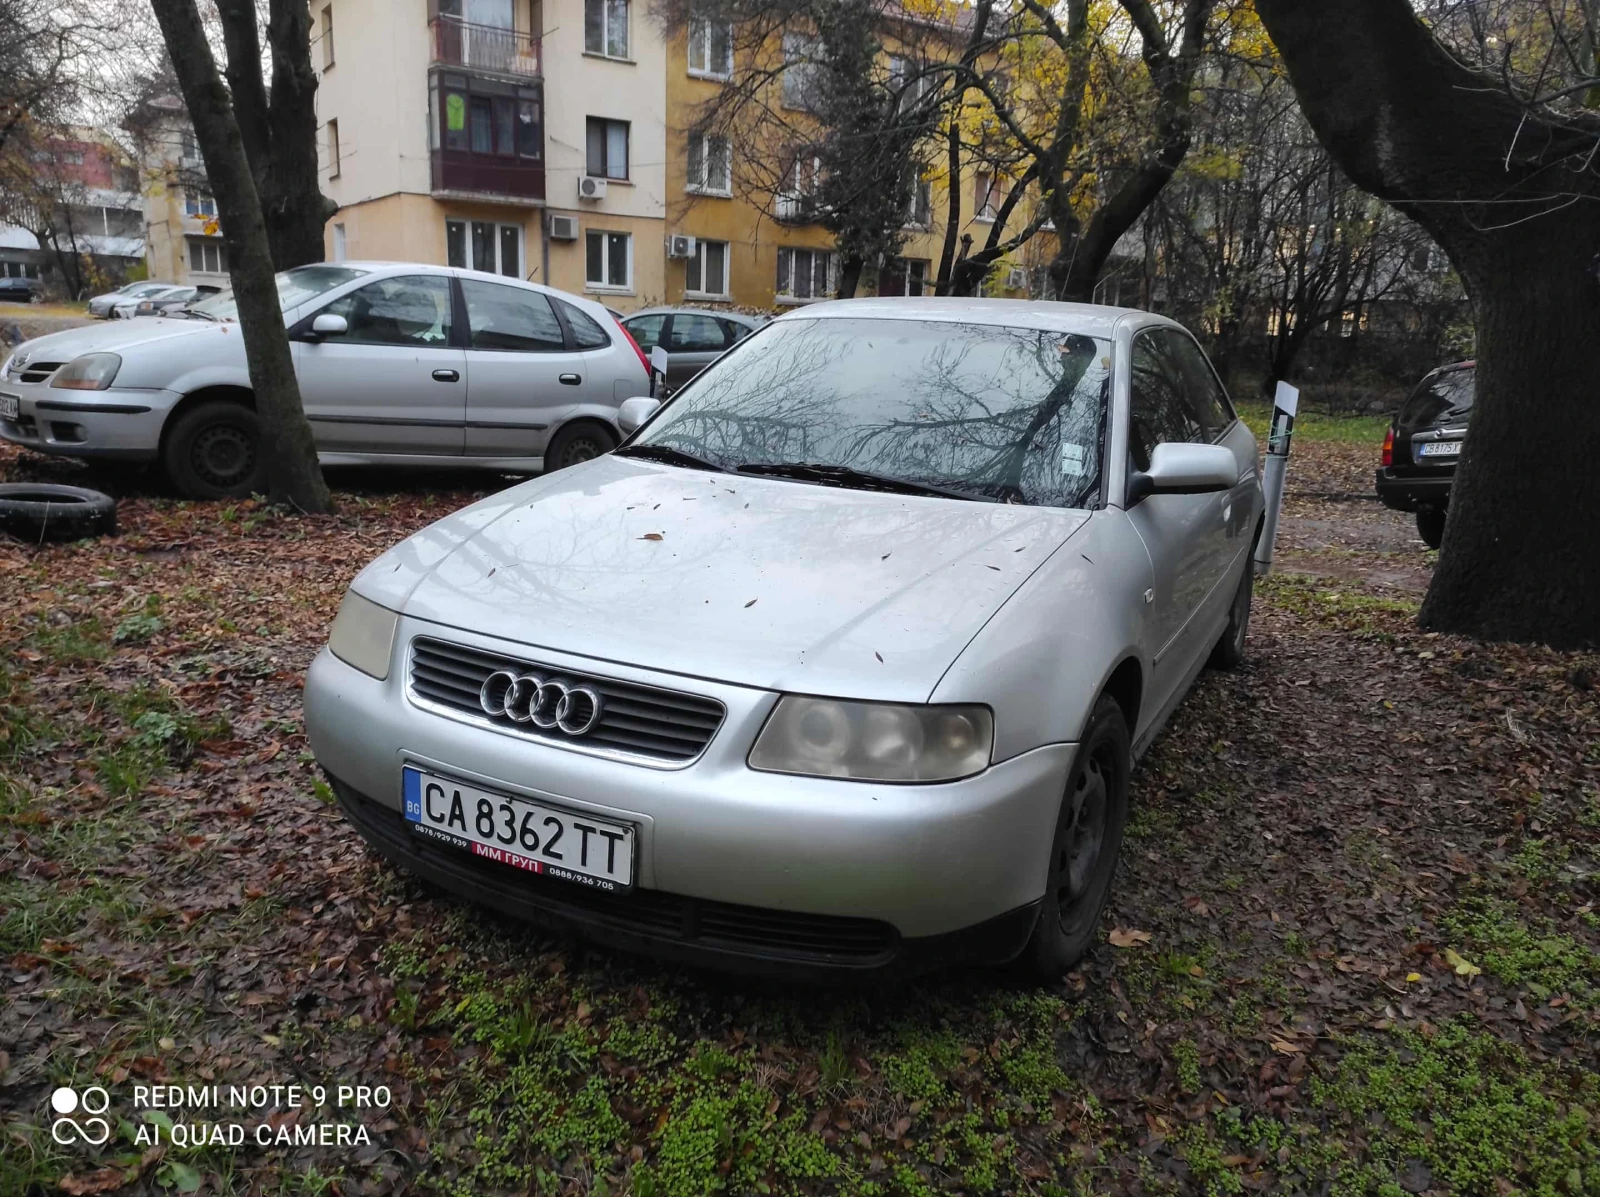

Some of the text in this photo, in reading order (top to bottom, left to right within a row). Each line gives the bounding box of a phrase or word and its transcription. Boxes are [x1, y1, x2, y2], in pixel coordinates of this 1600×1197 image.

[407, 800, 420, 815] BG
[425, 782, 624, 874] CA 8362 TT
[452, 837, 467, 848] 939
[476, 843, 539, 873] ММ ГРУП
[549, 867, 614, 891] 0888/936 705
